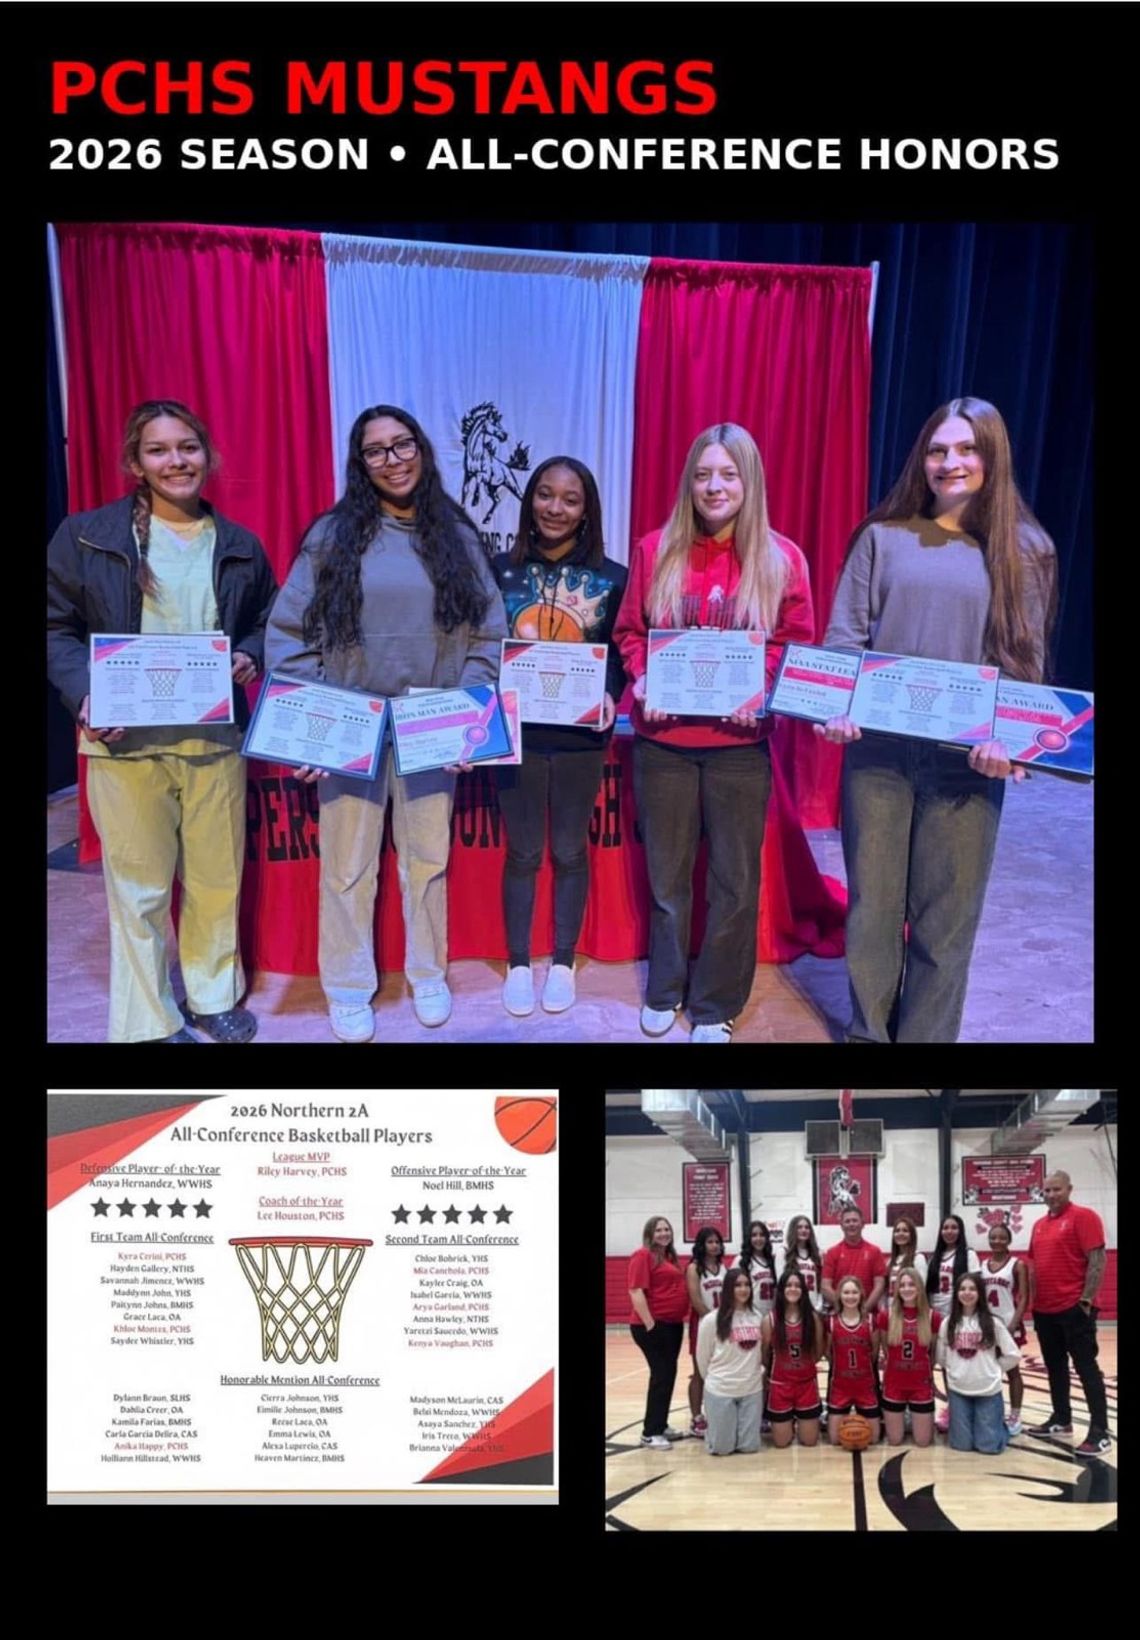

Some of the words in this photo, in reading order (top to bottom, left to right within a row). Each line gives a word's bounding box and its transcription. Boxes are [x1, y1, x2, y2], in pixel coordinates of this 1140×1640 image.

[438, 703, 470, 714] AWARD
[1011, 698, 1054, 711] AWARD
[230, 1102, 268, 1119] 2026
[270, 1102, 345, 1119] Northern
[348, 1102, 369, 1119] 2A
[170, 1126, 285, 1144] All-Conference
[288, 1127, 370, 1144] Basketball
[373, 1128, 433, 1146] Players
[272, 1151, 306, 1163] League
[307, 1151, 330, 1163] MVP
[257, 1166, 281, 1178] Riley
[282, 1167, 320, 1178] Harvey,
[321, 1167, 348, 1177] PCHS
[391, 1165, 437, 1177] Offensive
[88, 1178, 120, 1190] Anaya
[121, 1178, 176, 1190] Hernandez,
[177, 1179, 213, 1189] WWHS
[422, 1181, 445, 1190] Noel
[446, 1180, 464, 1191] Hill,
[465, 1181, 494, 1191] BMHS
[259, 1196, 289, 1208] Coach
[257, 1211, 274, 1221] Lee
[274, 1211, 318, 1222] Houston,
[319, 1211, 345, 1221] PCHS
[90, 1231, 114, 1243] First
[115, 1232, 143, 1244] Team
[385, 1234, 420, 1246] Second
[421, 1234, 448, 1246] Team
[165, 1252, 187, 1261] PCHS
[415, 1254, 437, 1263] Chloe
[110, 1264, 140, 1274] Hayden
[140, 1264, 172, 1274] Gallery,
[172, 1264, 195, 1273] NTHS
[413, 1267, 429, 1275] Mia
[468, 1267, 489, 1275] PCHS
[100, 1276, 139, 1284] Savannah
[140, 1276, 175, 1286] Jimenez,
[176, 1277, 205, 1285] WWHS
[446, 1279, 470, 1288] Craig,
[470, 1279, 484, 1287] OA
[151, 1289, 174, 1298] John,
[175, 1289, 192, 1297] YHS
[463, 1291, 492, 1299] WWHS
[143, 1300, 170, 1310] Johns,
[170, 1301, 194, 1309] BMHS
[468, 1303, 489, 1311] PCHS
[168, 1313, 181, 1321] OA
[413, 1315, 434, 1323] Anna
[466, 1315, 489, 1323] NTHS
[170, 1325, 191, 1333] PCHS
[470, 1327, 499, 1335] WWHS
[178, 1337, 194, 1345] YHS
[471, 1339, 493, 1347] PCHS
[902, 1340, 914, 1360] 2
[848, 1349, 857, 1369] 1
[220, 1375, 270, 1387] Honorable
[271, 1375, 311, 1387] Mention
[286, 1393, 322, 1403] Johnson,
[323, 1394, 340, 1403] YHS
[410, 1396, 446, 1405] Madyson
[487, 1396, 504, 1404] CAS
[284, 1406, 320, 1415] Johnson,
[319, 1406, 343, 1414] BMHS
[433, 1407, 470, 1417] Mendoza,
[471, 1408, 501, 1416] WWHS
[168, 1418, 192, 1426] BMHS
[315, 1418, 328, 1426] OA
[105, 1430, 127, 1438] Carla
[127, 1430, 154, 1438] Garcia
[181, 1430, 198, 1438] CAS
[268, 1430, 293, 1438] Emma
[293, 1430, 318, 1439] Lewis,
[319, 1430, 331, 1438] OA
[167, 1442, 189, 1450] PCHS
[262, 1442, 284, 1450] Alexa
[321, 1442, 338, 1450] CAS
[172, 1454, 202, 1462] WWHS
[254, 1454, 283, 1462] Heaven
[283, 1454, 321, 1464] Martinez,
[321, 1455, 345, 1463] BMHS
